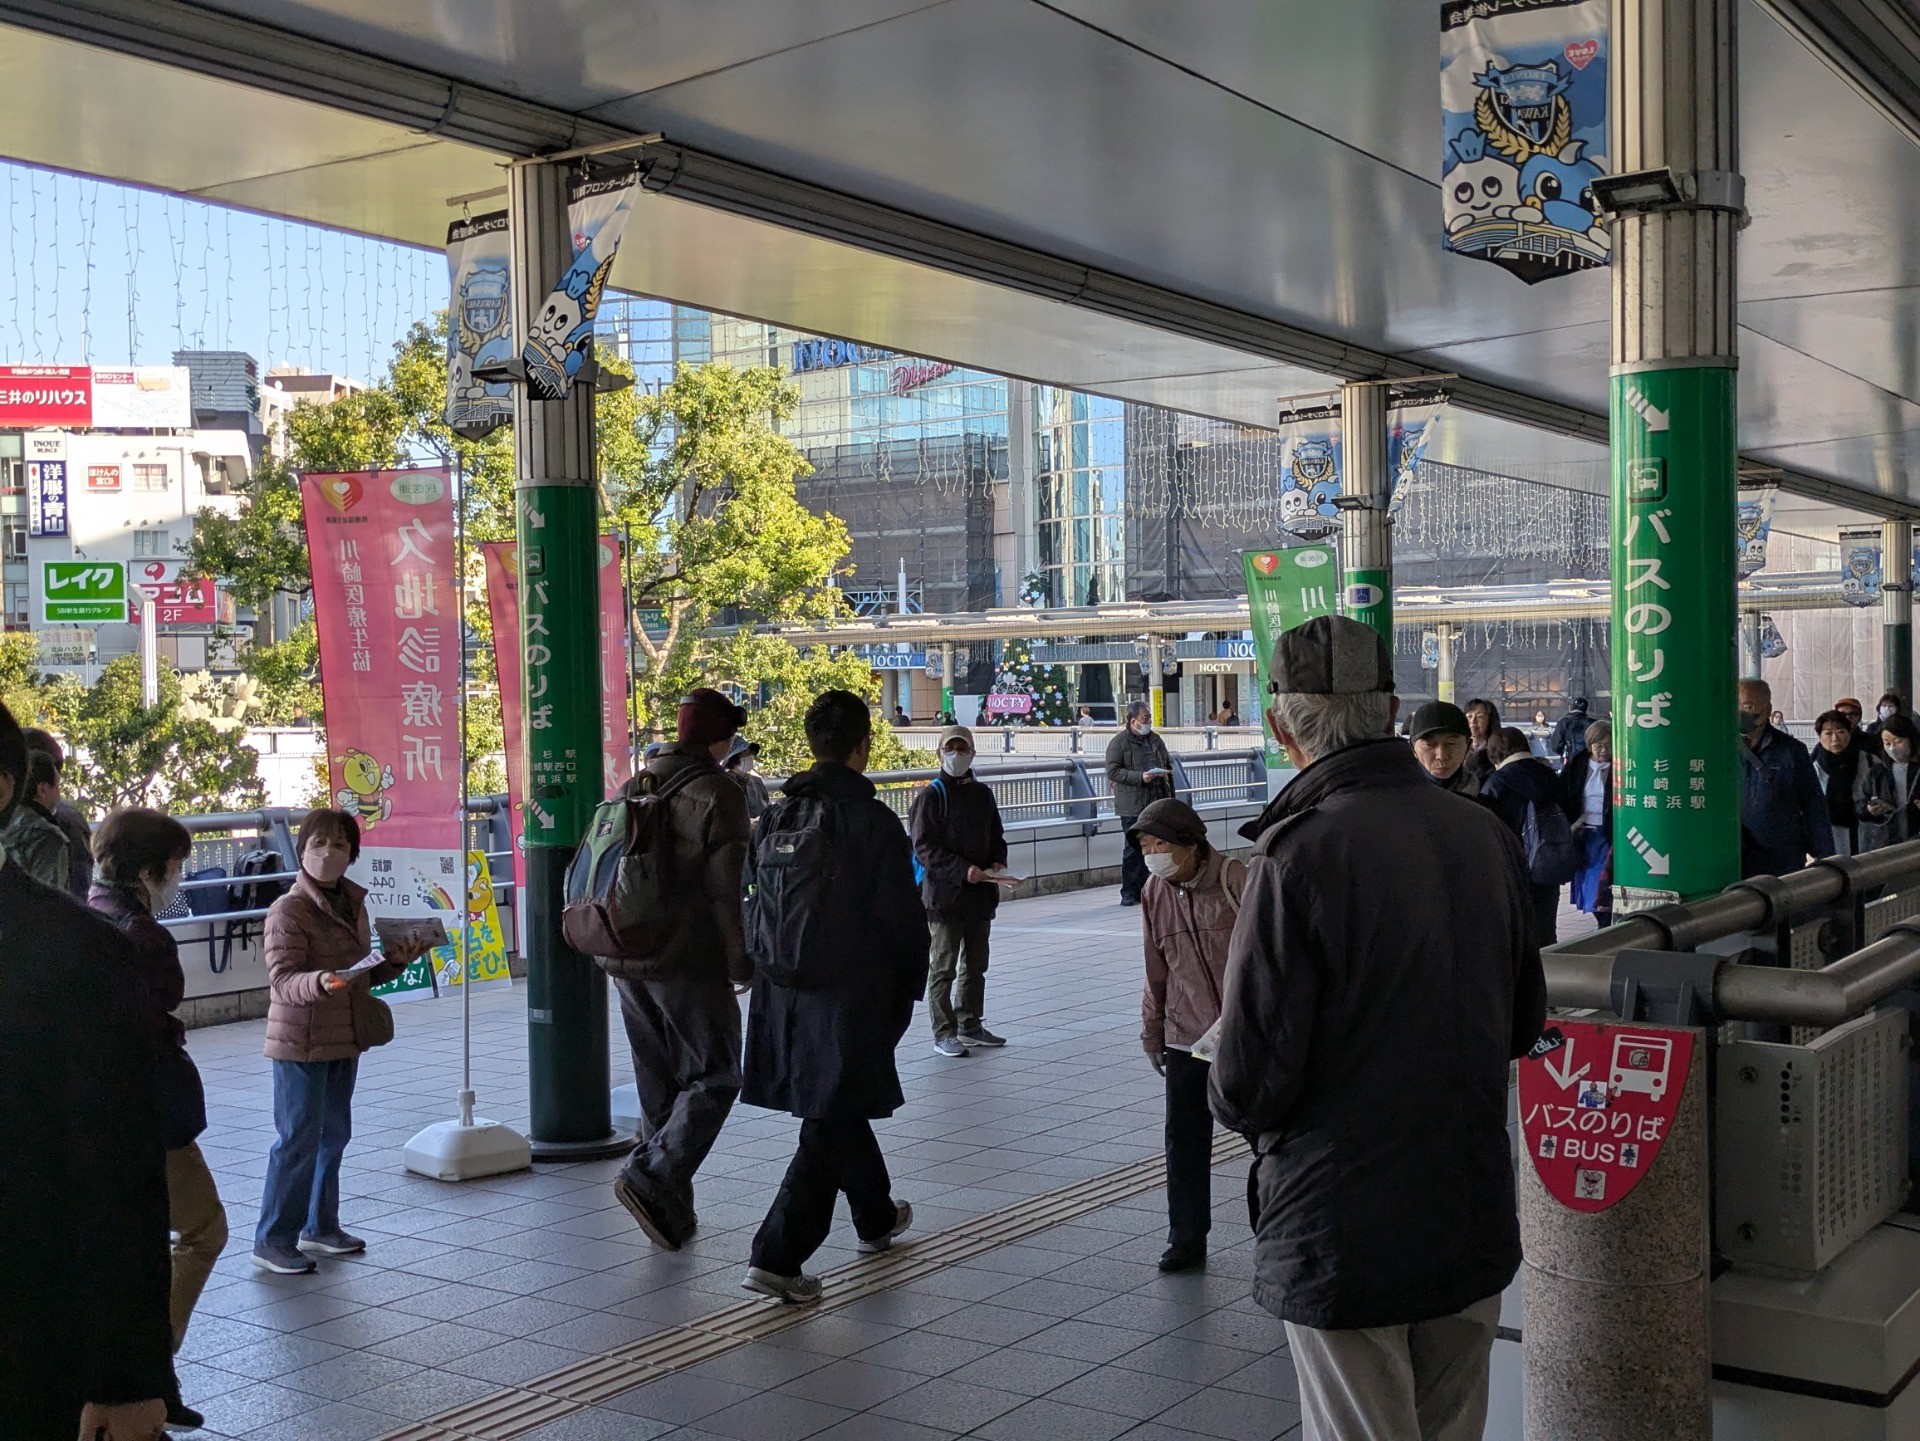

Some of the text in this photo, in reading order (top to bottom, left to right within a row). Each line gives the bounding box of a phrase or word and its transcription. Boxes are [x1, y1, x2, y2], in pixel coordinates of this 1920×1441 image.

[0, 389, 87, 405] 三井のリハウス
[43, 463, 65, 533] 洋服の青山
[49, 568, 114, 590] レイク
[164, 609, 182, 621] 2F
[1622, 510, 1673, 728] バスのりば
[521, 580, 553, 730] バスのりば
[870, 655, 913, 667] NOCTY
[1199, 663, 1232, 672] NOCTY
[988, 697, 1027, 708] NOCTY
[1625, 758, 1705, 772] 小杉駅
[1625, 776, 1705, 790] 川崎駅
[1625, 794, 1706, 809] 新横浜駅
[1525, 1103, 1665, 1142] バスのりば
[1563, 1138, 1615, 1163] BUS
